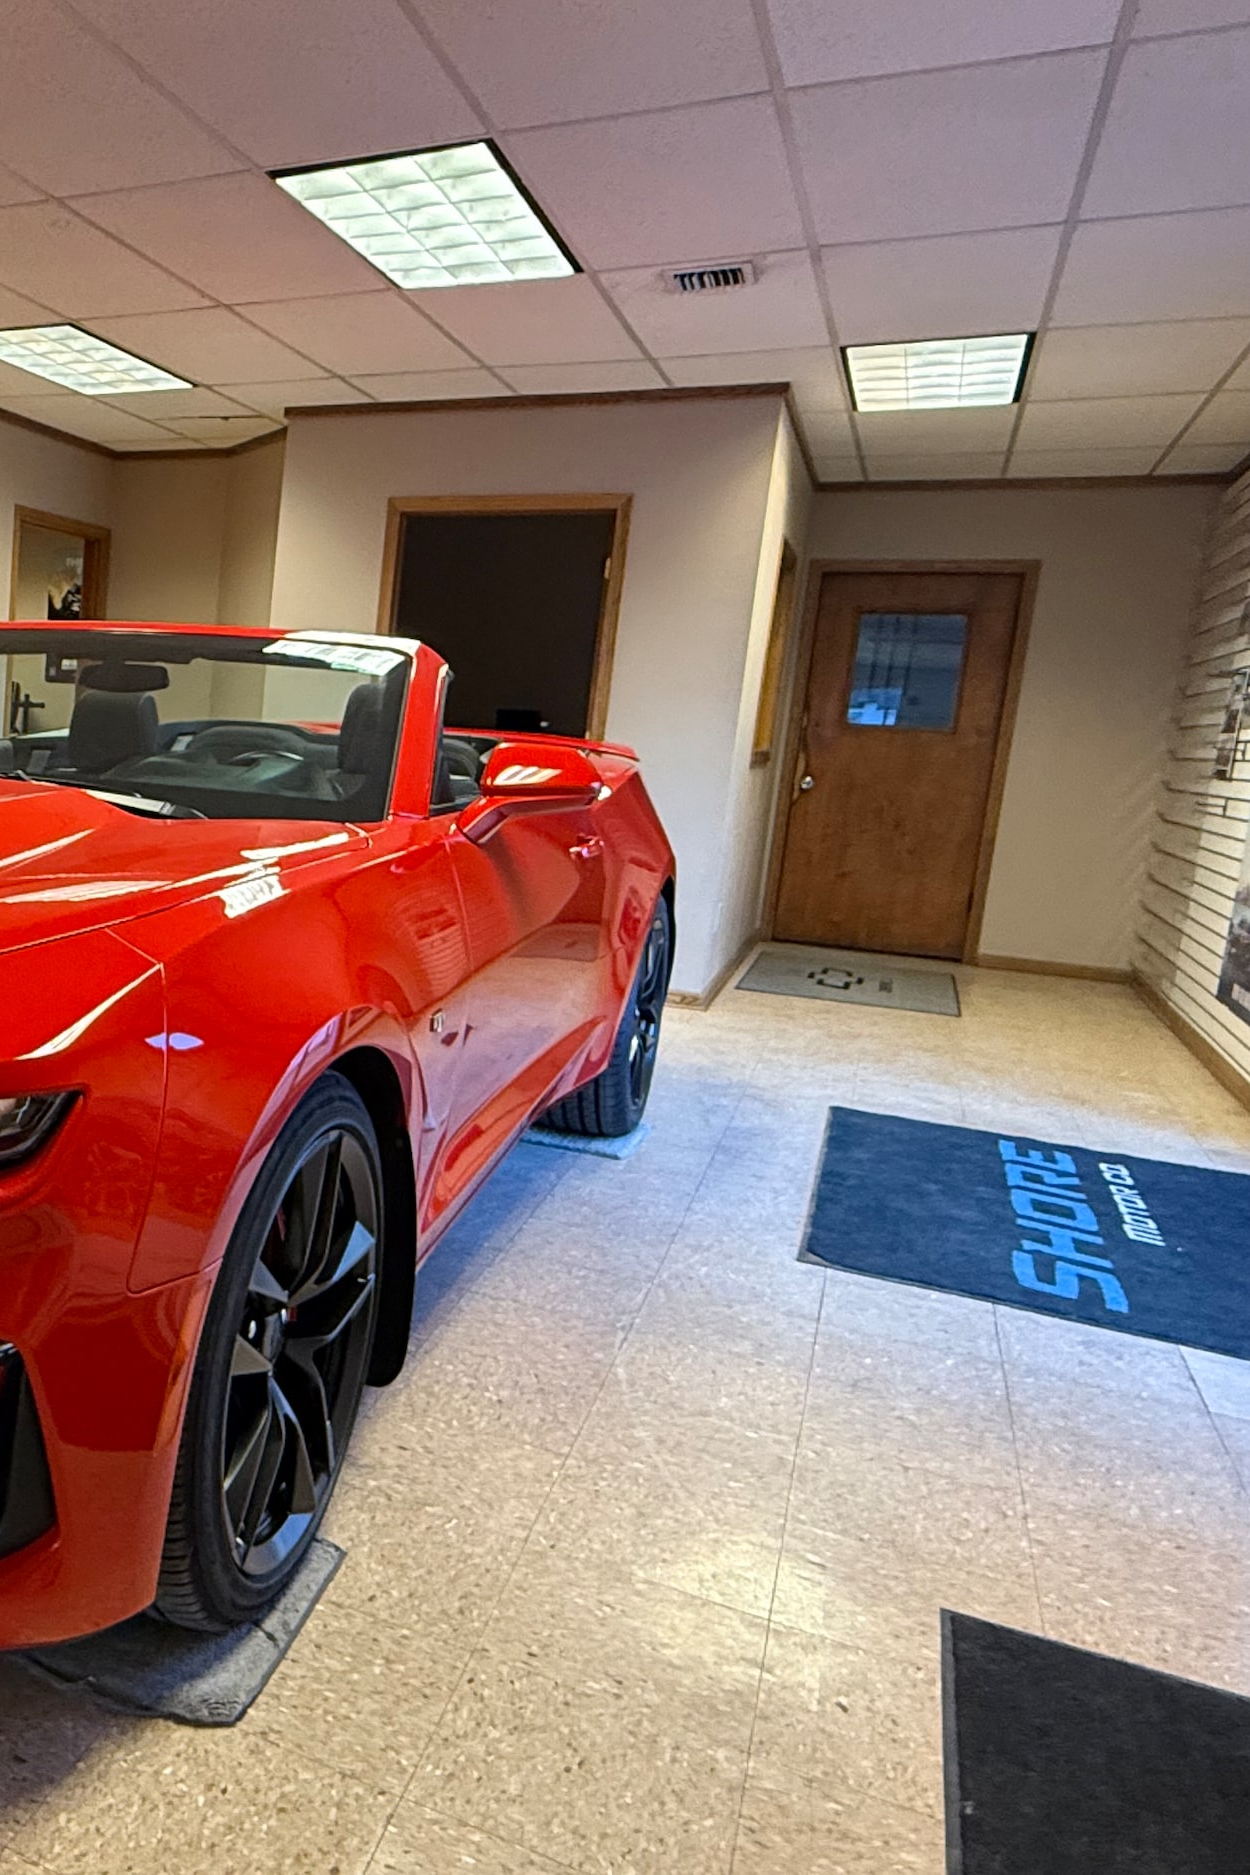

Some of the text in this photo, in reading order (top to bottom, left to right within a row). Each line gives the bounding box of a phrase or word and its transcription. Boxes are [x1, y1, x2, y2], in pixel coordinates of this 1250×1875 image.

[998, 1138, 1129, 1314] SHORE
[1098, 1162, 1166, 1247] MOTOR CO
